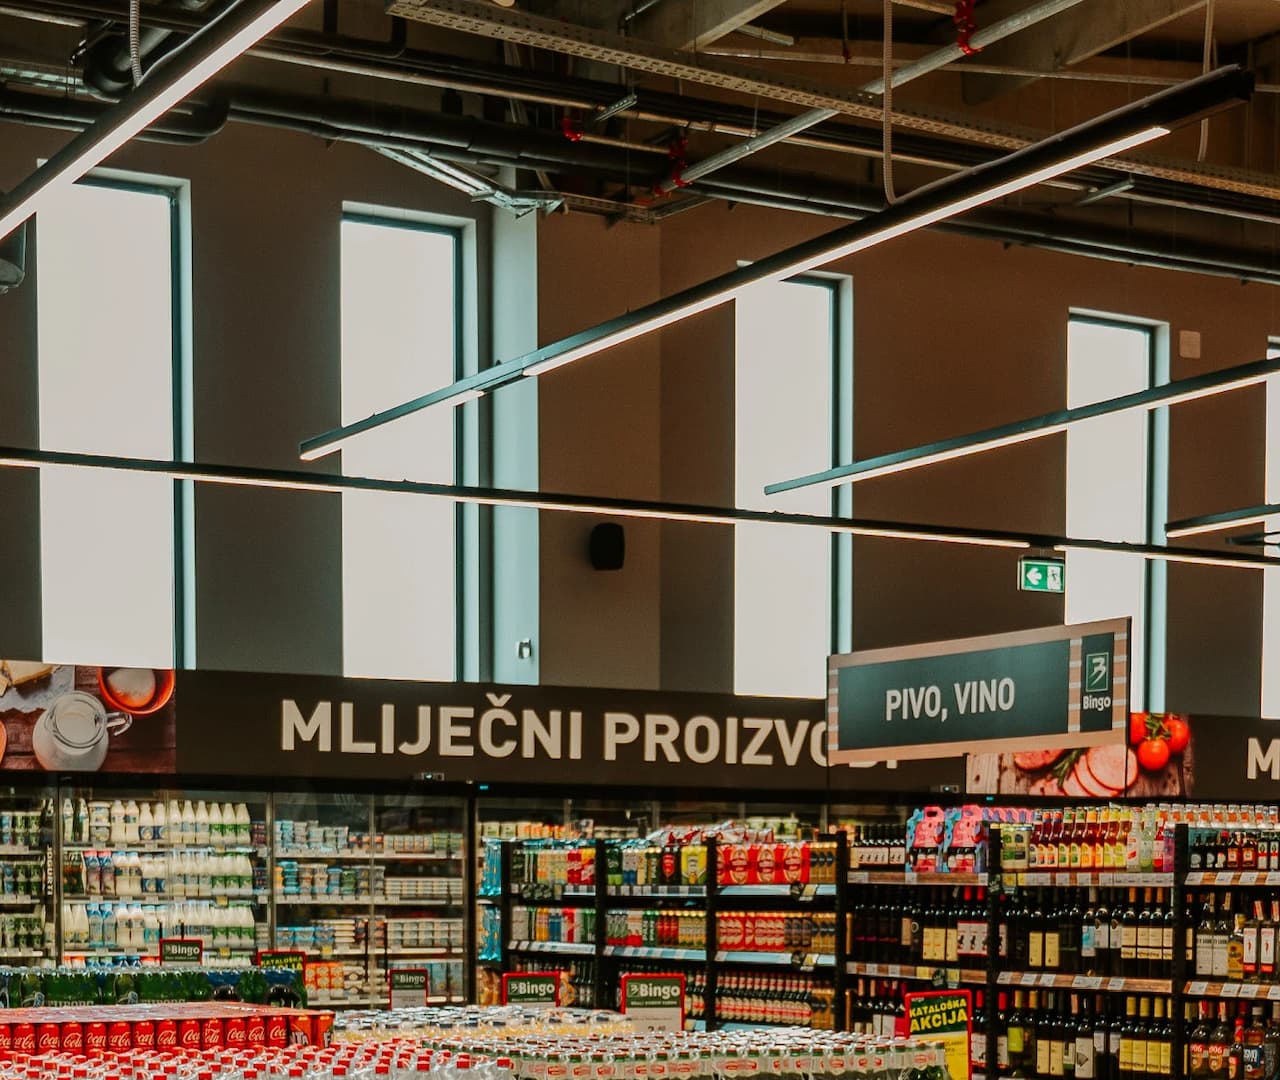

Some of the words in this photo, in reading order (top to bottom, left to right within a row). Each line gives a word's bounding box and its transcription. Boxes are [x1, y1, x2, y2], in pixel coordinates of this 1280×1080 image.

[886, 685, 948, 723] PIVO,
[954, 677, 1016, 714] VINO
[1083, 695, 1111, 712] Bingo
[281, 693, 582, 760] MLIJEČNI
[604, 711, 898, 769] PROIZVO
[171, 944, 200, 956] Bingo
[400, 974, 426, 985] Bingo
[519, 980, 555, 997] Bingo
[640, 983, 681, 999] Bingo
[910, 998, 967, 1017] KATALOŠKA
[910, 1009, 968, 1032] AKCIJA
